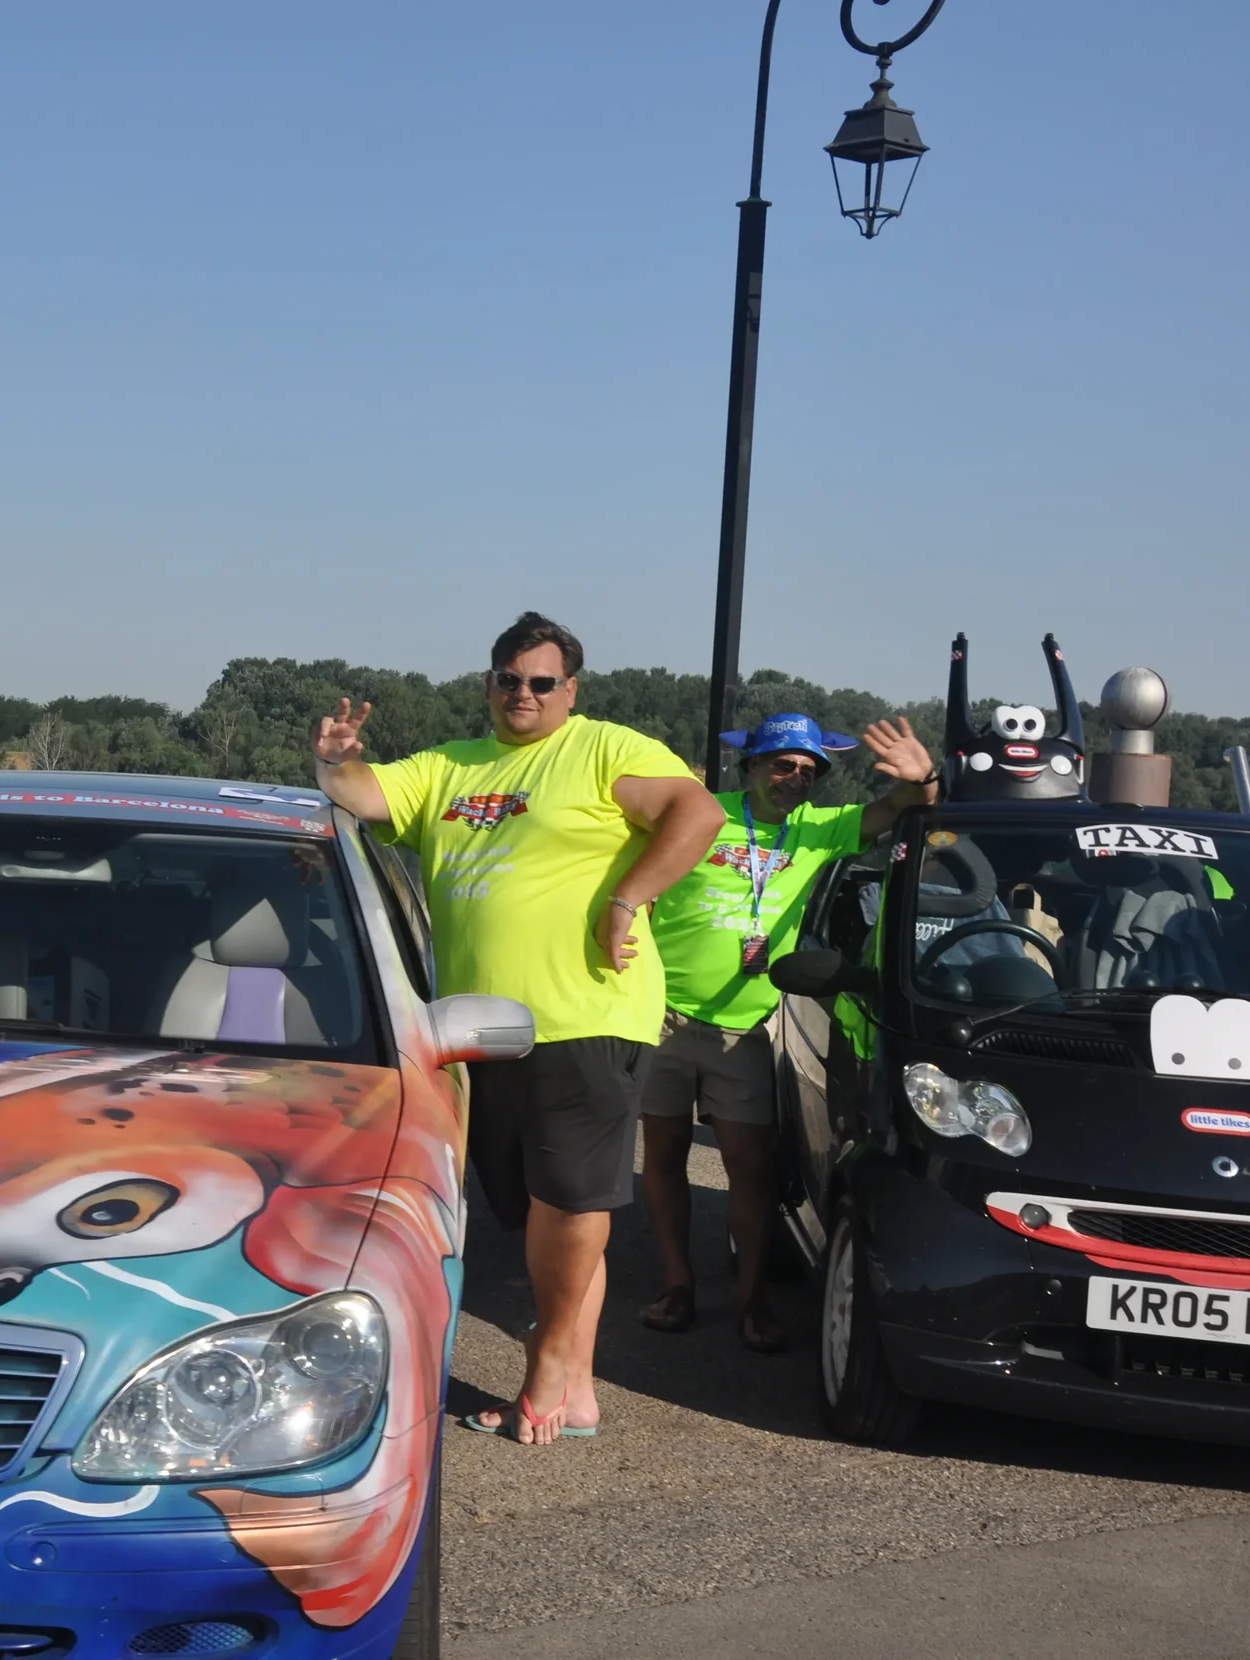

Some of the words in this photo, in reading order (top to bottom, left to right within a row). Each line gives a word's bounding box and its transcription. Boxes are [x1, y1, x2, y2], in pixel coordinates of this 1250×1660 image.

[73, 795, 225, 815] Barcelona
[1082, 826, 1214, 857] TAXI
[1190, 1114, 1219, 1126] little
[1221, 1117, 1250, 1128] tikes
[1110, 1284, 1231, 1332] KR05
